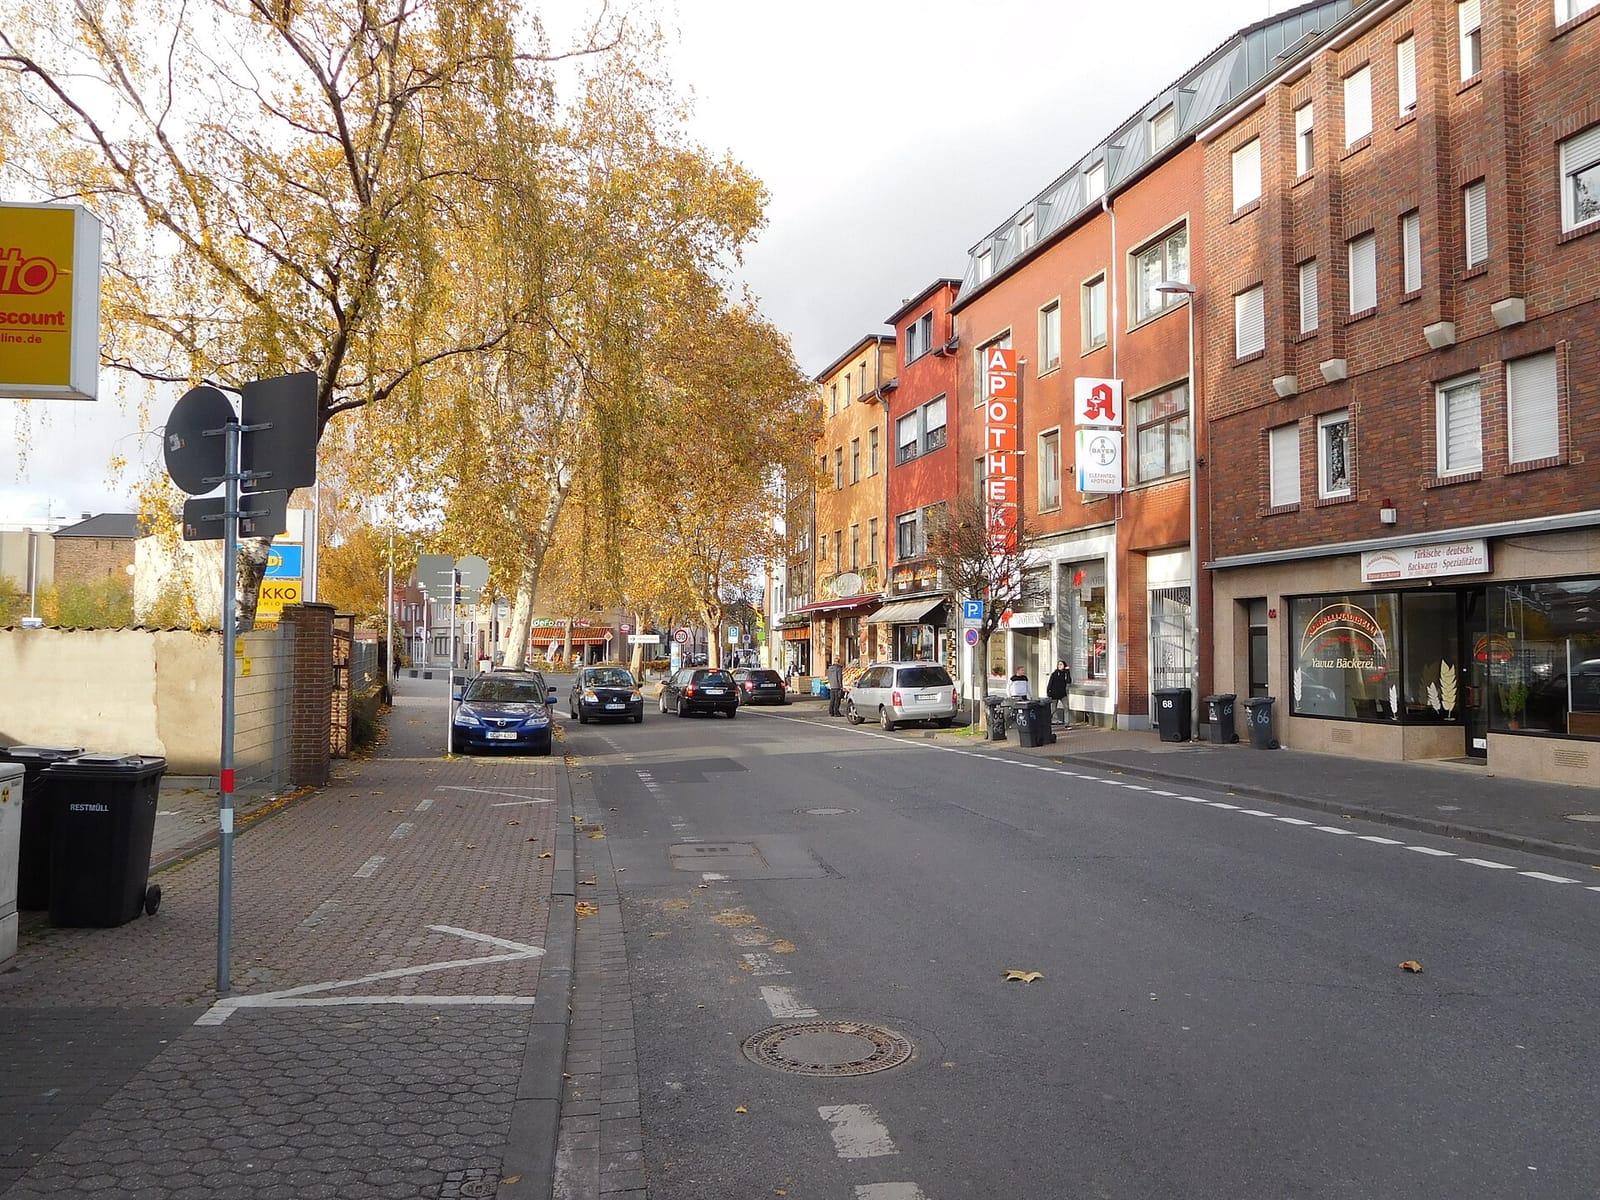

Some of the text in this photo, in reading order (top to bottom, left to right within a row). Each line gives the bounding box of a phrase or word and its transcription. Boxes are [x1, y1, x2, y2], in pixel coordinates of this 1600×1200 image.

[989, 350, 1008, 555] APOTHEKE
[1413, 543, 1474, 560] Türkische deutsche
[968, 602, 979, 617] P
[677, 632, 686, 641] 30
[1312, 657, 1375, 669] Yavuz Bäckerei
[1162, 700, 1173, 709] 68
[1223, 703, 1233, 716] 66
[1256, 708, 1270, 724] 66
[70, 802, 110, 812] RESTMÜLL
